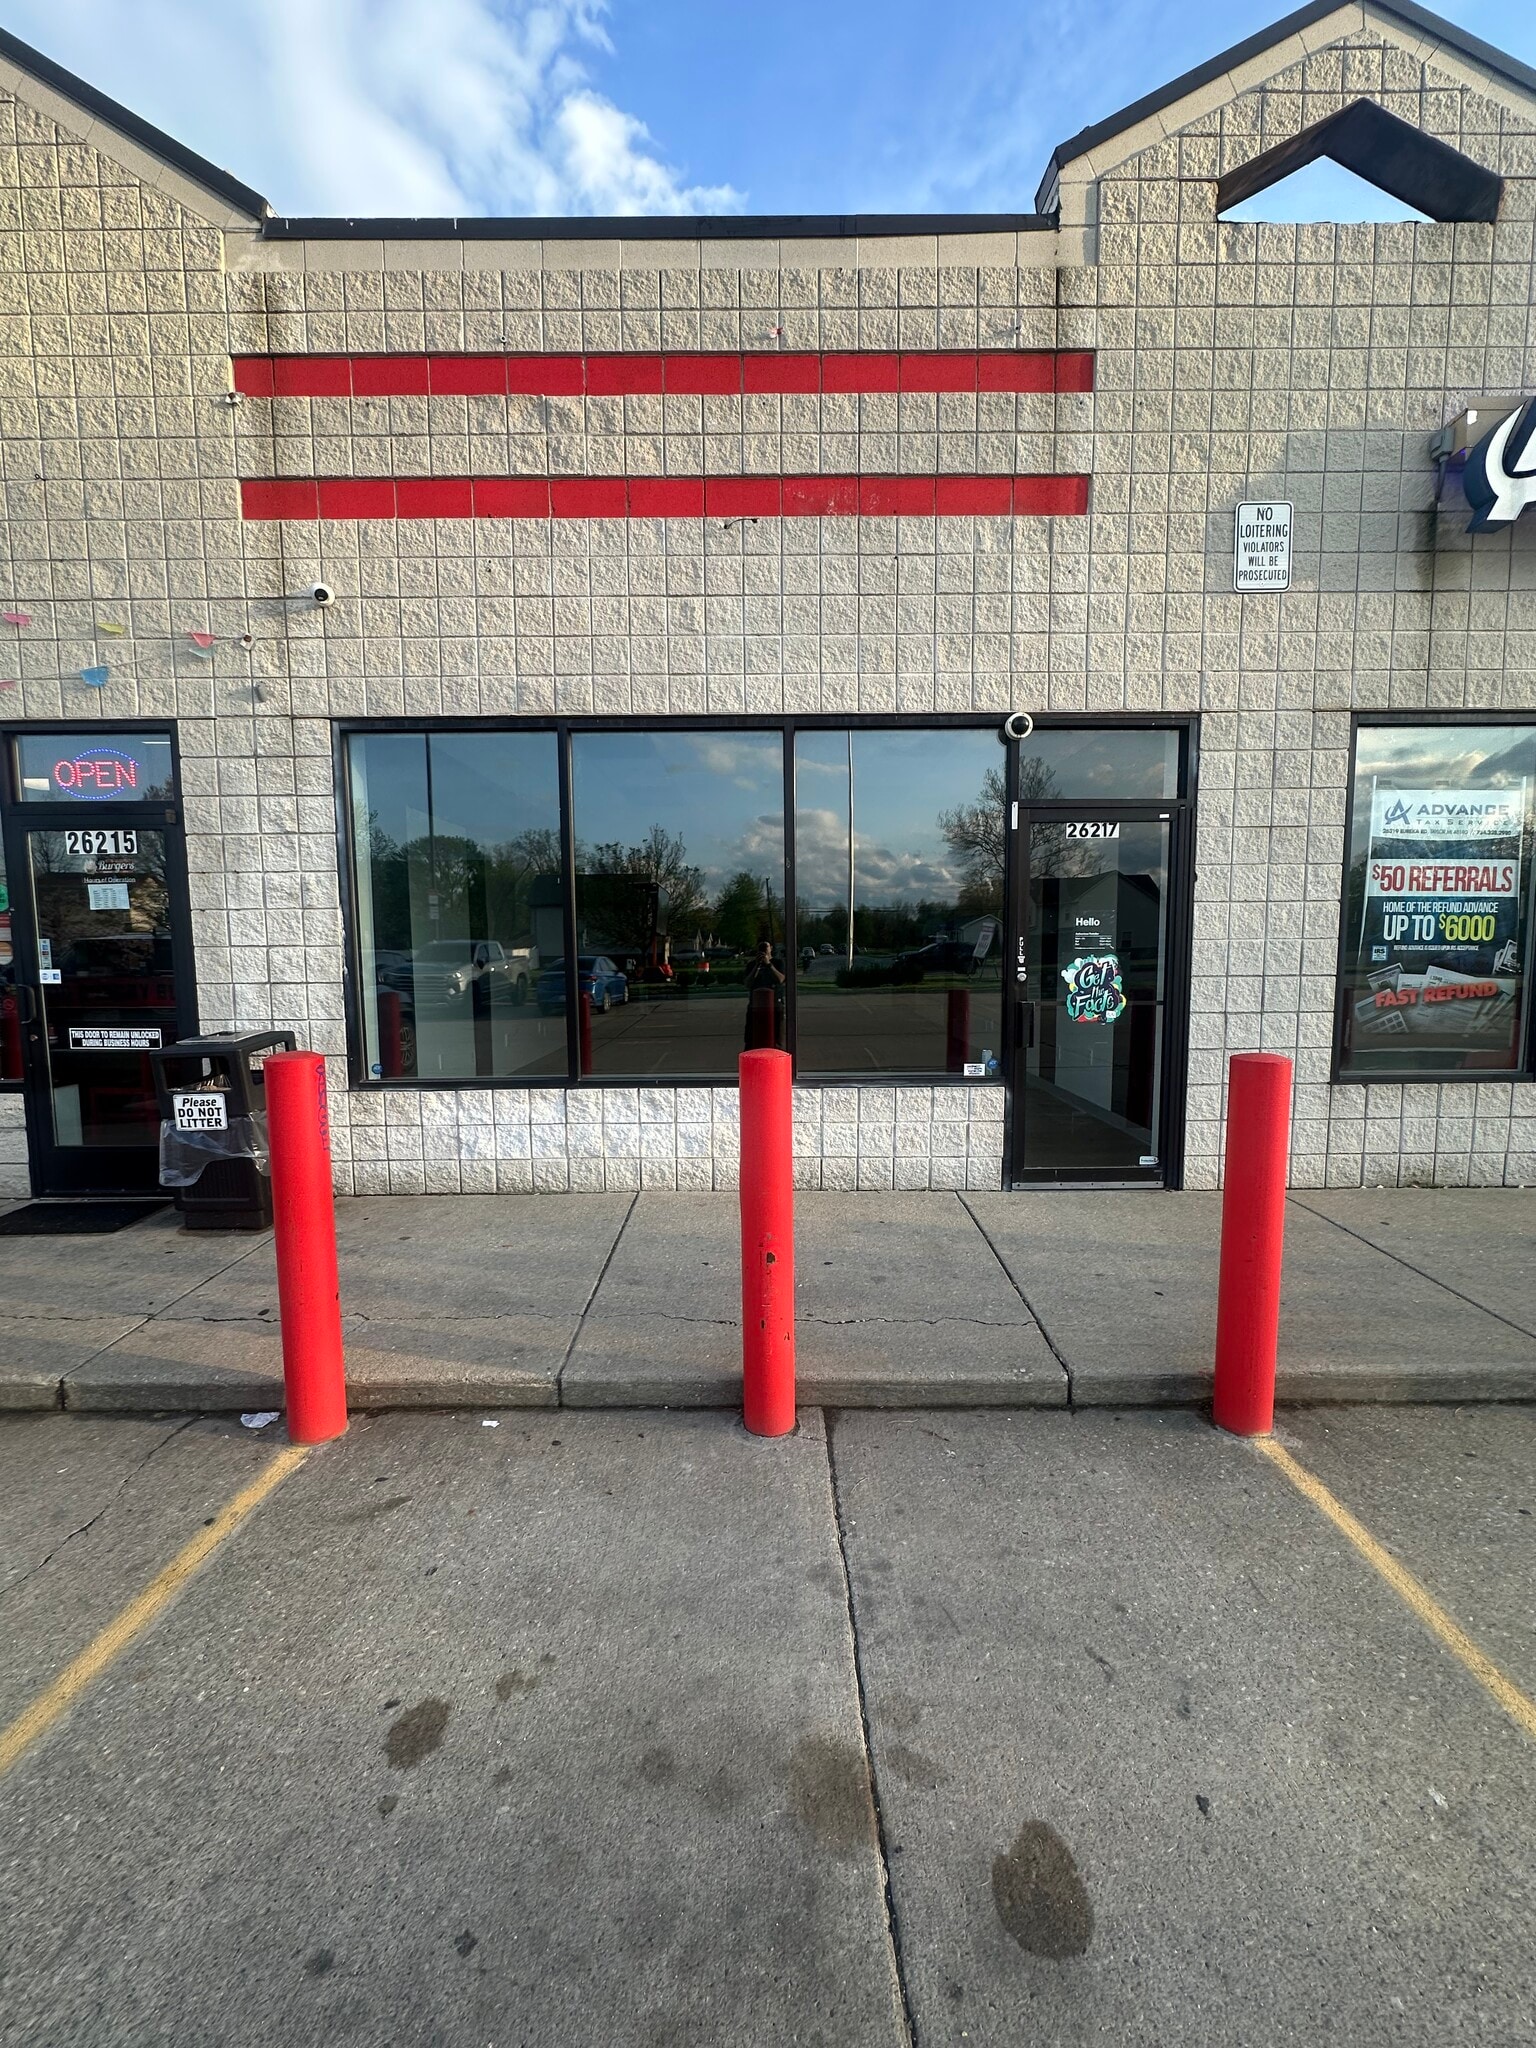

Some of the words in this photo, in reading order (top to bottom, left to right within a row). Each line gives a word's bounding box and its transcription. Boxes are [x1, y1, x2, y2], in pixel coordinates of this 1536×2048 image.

[1256, 507, 1273, 521] NO
[1240, 524, 1288, 538] LOITERING
[1243, 541, 1284, 553] VIOLATORS
[1248, 556, 1265, 566] WILL
[1269, 556, 1278, 566] BE
[1239, 570, 1287, 580] PROSECUTED
[54, 760, 136, 787] OPEN
[1417, 804, 1510, 816] ADVANCE
[1067, 823, 1118, 838] 26217
[67, 831, 135, 854] 26215
[99, 861, 135, 873] Burgers
[1372, 864, 1405, 892] $50
[1408, 865, 1513, 893] REFERRALS
[1383, 901, 1405, 913] HOME
[1405, 901, 1416, 913] OF
[1416, 901, 1432, 913] THE
[1432, 901, 1462, 913] REFUND
[1463, 901, 1499, 914] ADVANCE
[1075, 917, 1100, 926] Hello
[1383, 914, 1409, 941] UP
[1411, 914, 1435, 941] TO
[1438, 912, 1496, 941] $6000
[1079, 962, 1112, 989] Get
[1375, 990, 1419, 1008] FAST
[1423, 981, 1499, 1002] REFUND
[1074, 989, 1114, 1018] Facts
[71, 1030, 84, 1039] THIS
[84, 1030, 101, 1039] DOOR
[101, 1031, 109, 1039] TO
[109, 1031, 130, 1039] REMAIN
[130, 1031, 160, 1039] UNLOCKED
[82, 1039, 103, 1047] DURING
[104, 1039, 130, 1047] BUSINESS
[130, 1039, 150, 1047] HOURS
[182, 1097, 217, 1107] Please
[178, 1108, 194, 1118] DO
[198, 1107, 222, 1117] NOT
[180, 1118, 222, 1128] LITTER
